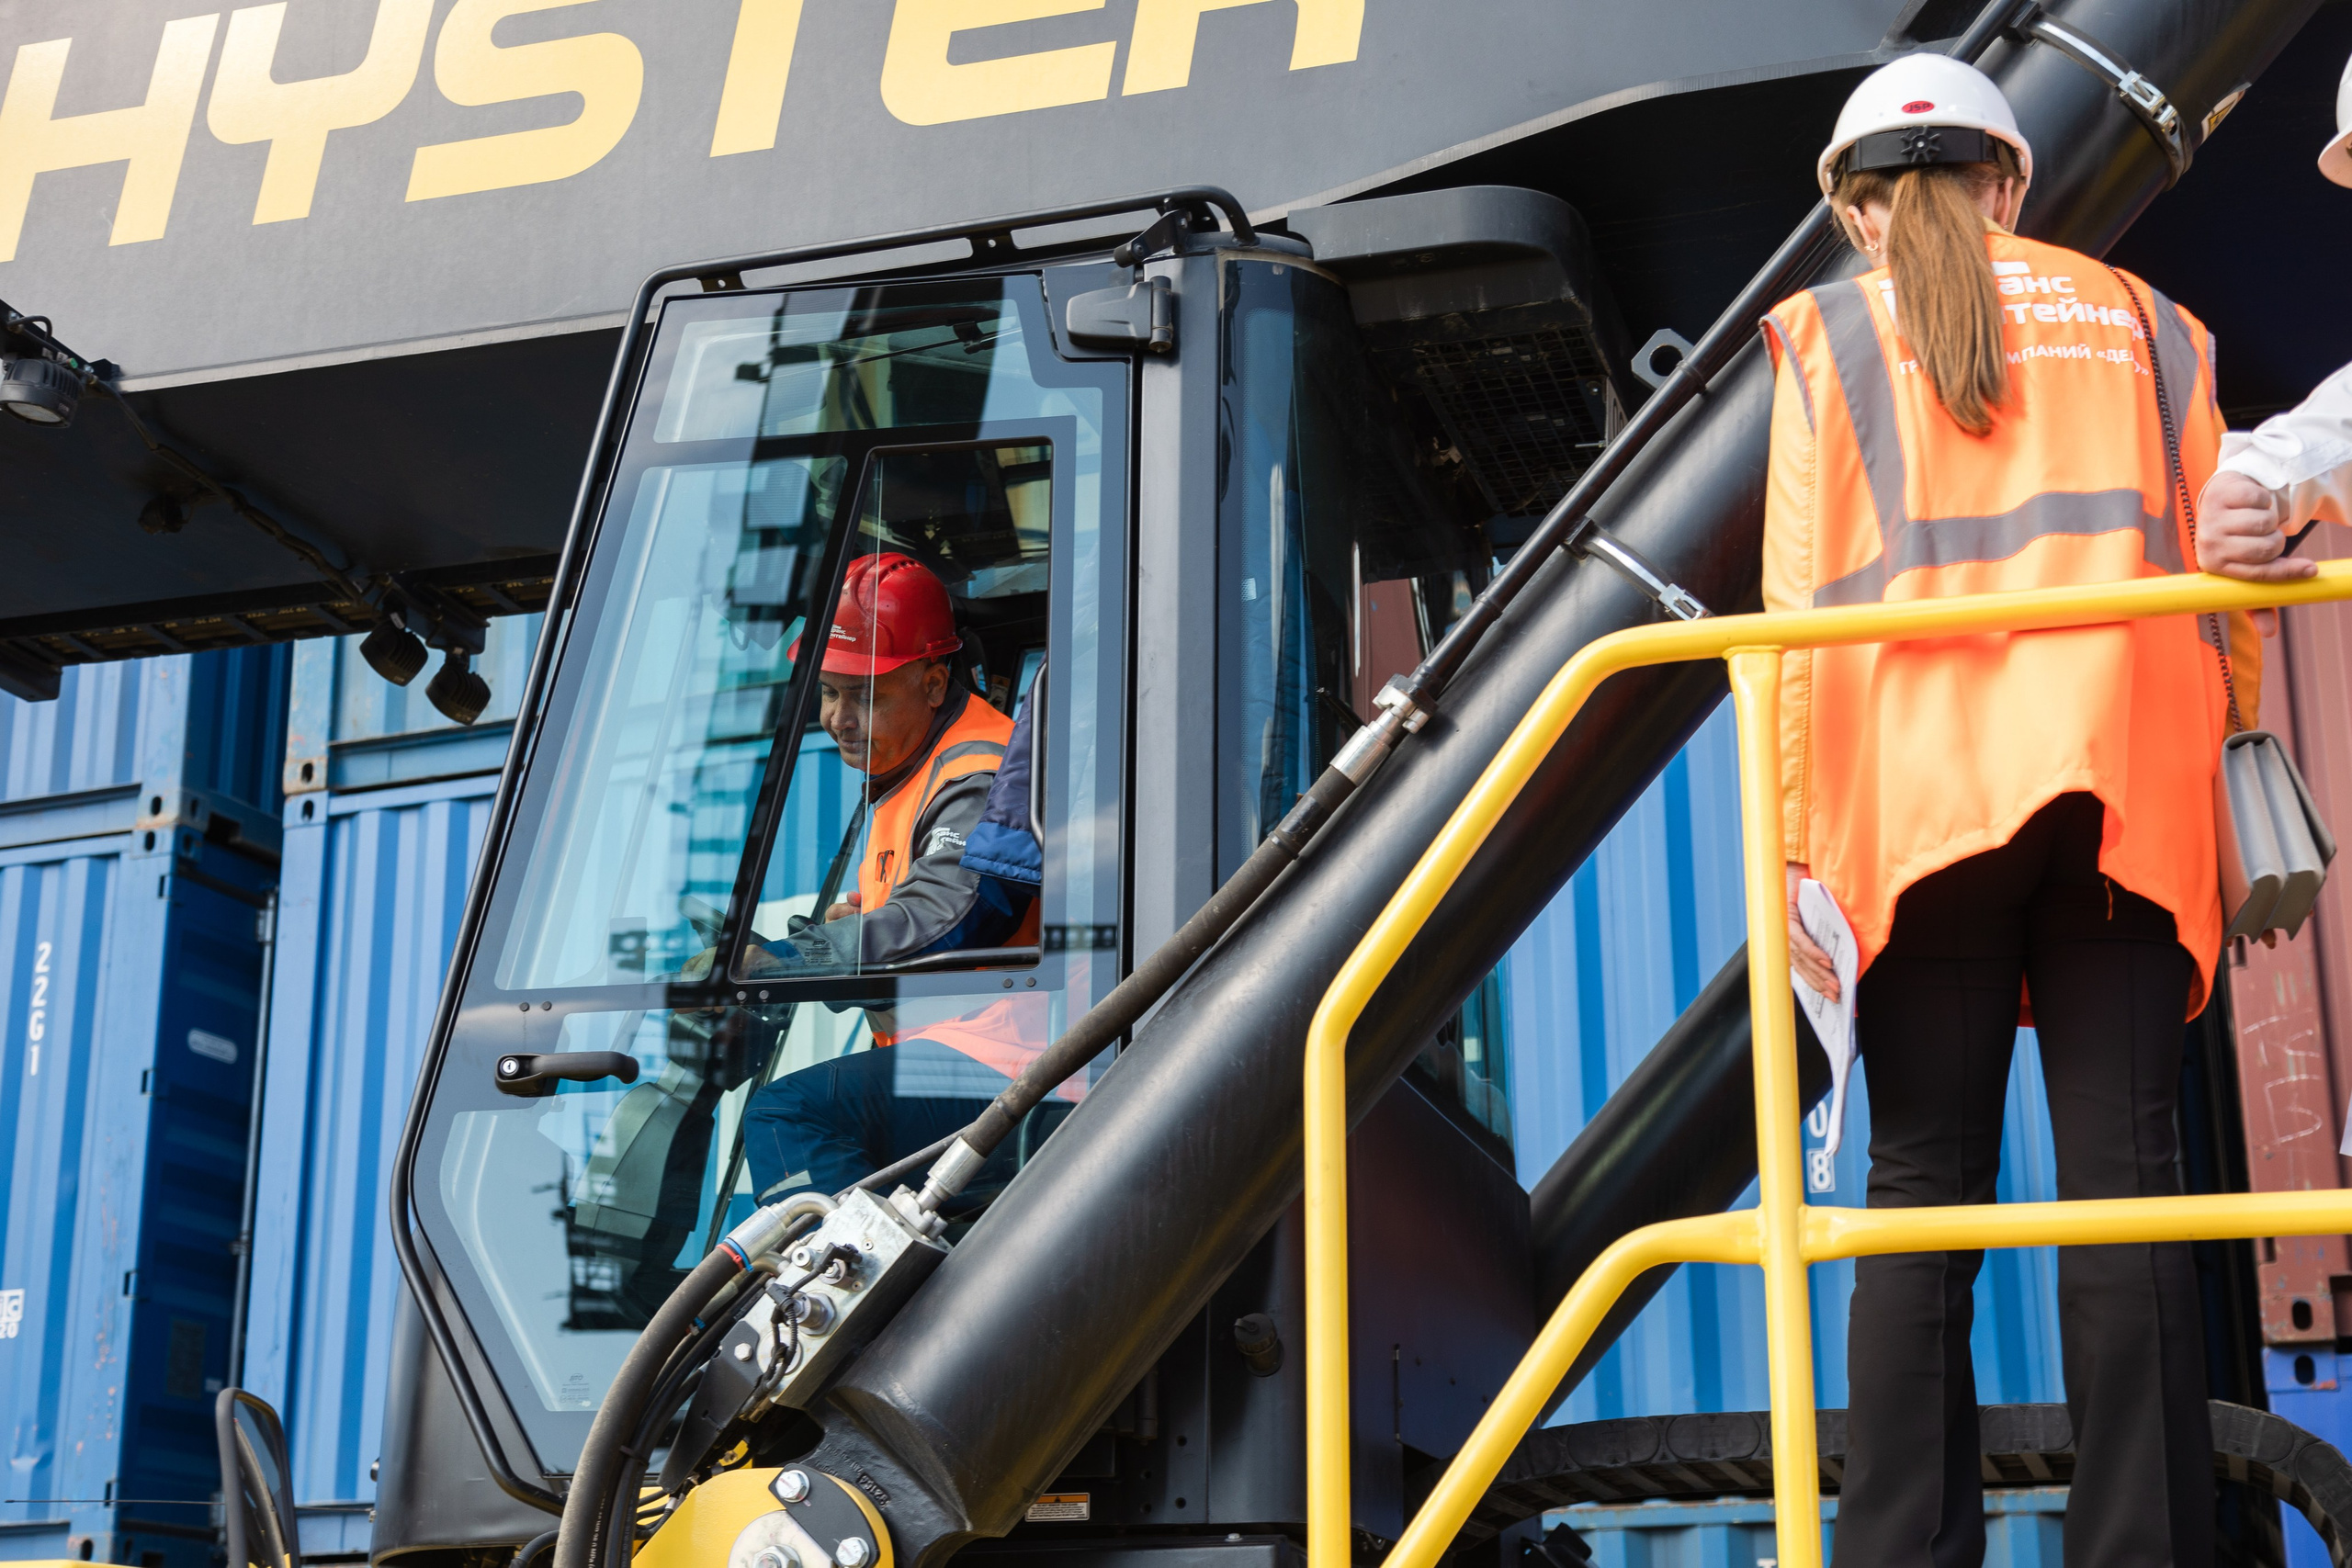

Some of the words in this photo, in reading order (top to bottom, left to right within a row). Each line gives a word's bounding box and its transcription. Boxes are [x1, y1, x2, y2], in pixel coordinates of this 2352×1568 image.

[1907, 102, 1931, 112] JSP
[1997, 276, 2076, 296] анс
[2006, 344, 2092, 365] МПАНИЙ
[29, 941, 52, 1077] 22G1
